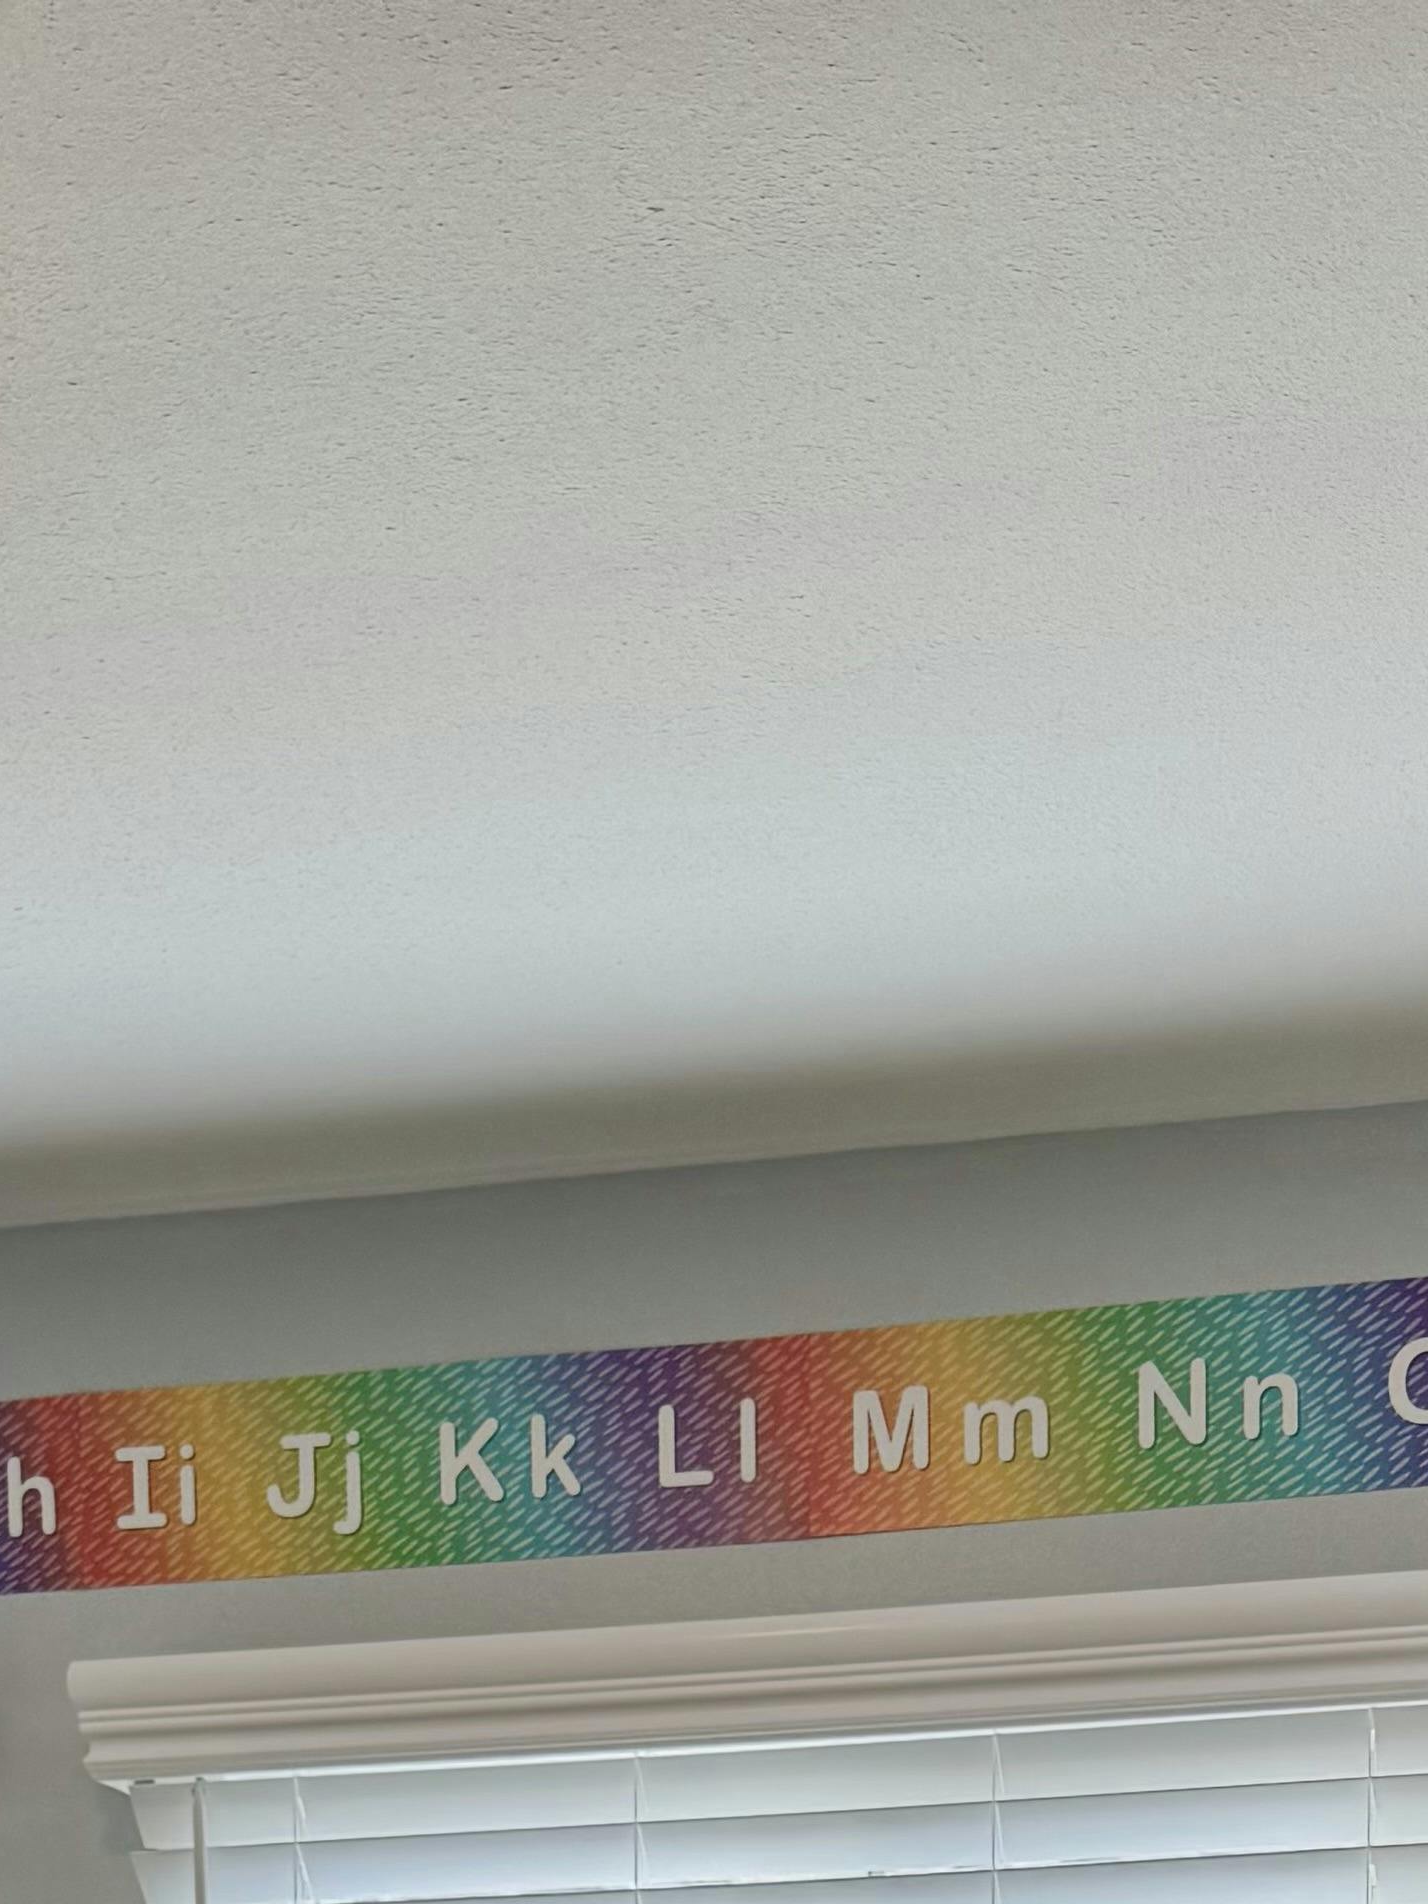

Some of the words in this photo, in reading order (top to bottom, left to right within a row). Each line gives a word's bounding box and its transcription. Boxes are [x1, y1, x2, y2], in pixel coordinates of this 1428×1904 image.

[267, 1433, 361, 1533] Jj
[439, 1414, 580, 1504] Kk
[853, 1386, 1047, 1473] Mm
[1139, 1358, 1298, 1448] Nn
